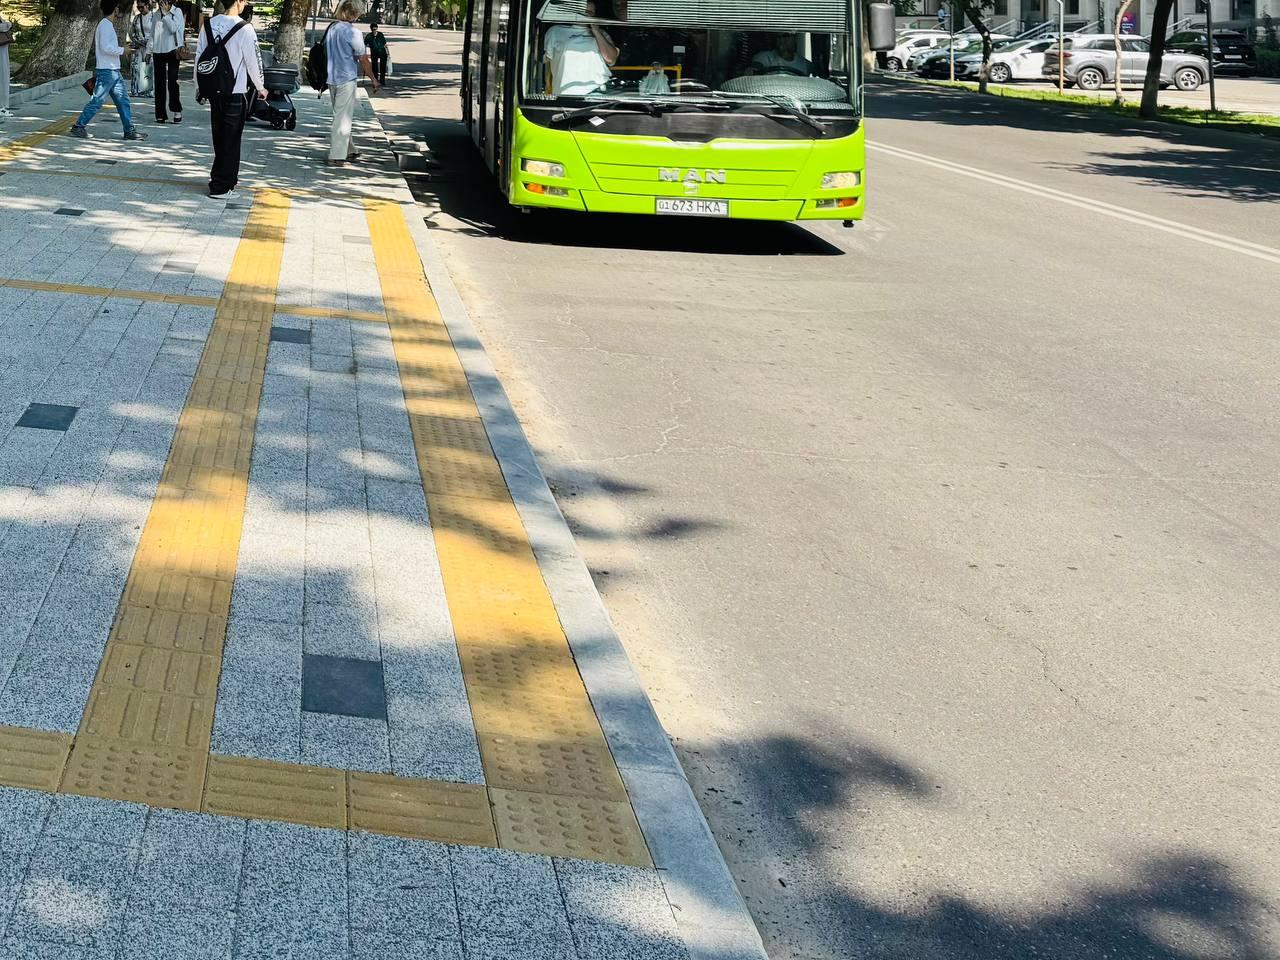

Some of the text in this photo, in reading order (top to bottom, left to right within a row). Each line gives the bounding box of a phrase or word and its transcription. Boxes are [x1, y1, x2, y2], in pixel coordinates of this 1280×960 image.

[658, 168, 726, 184] MAN
[672, 200, 693, 212] 673
[697, 201, 721, 213] HKA
